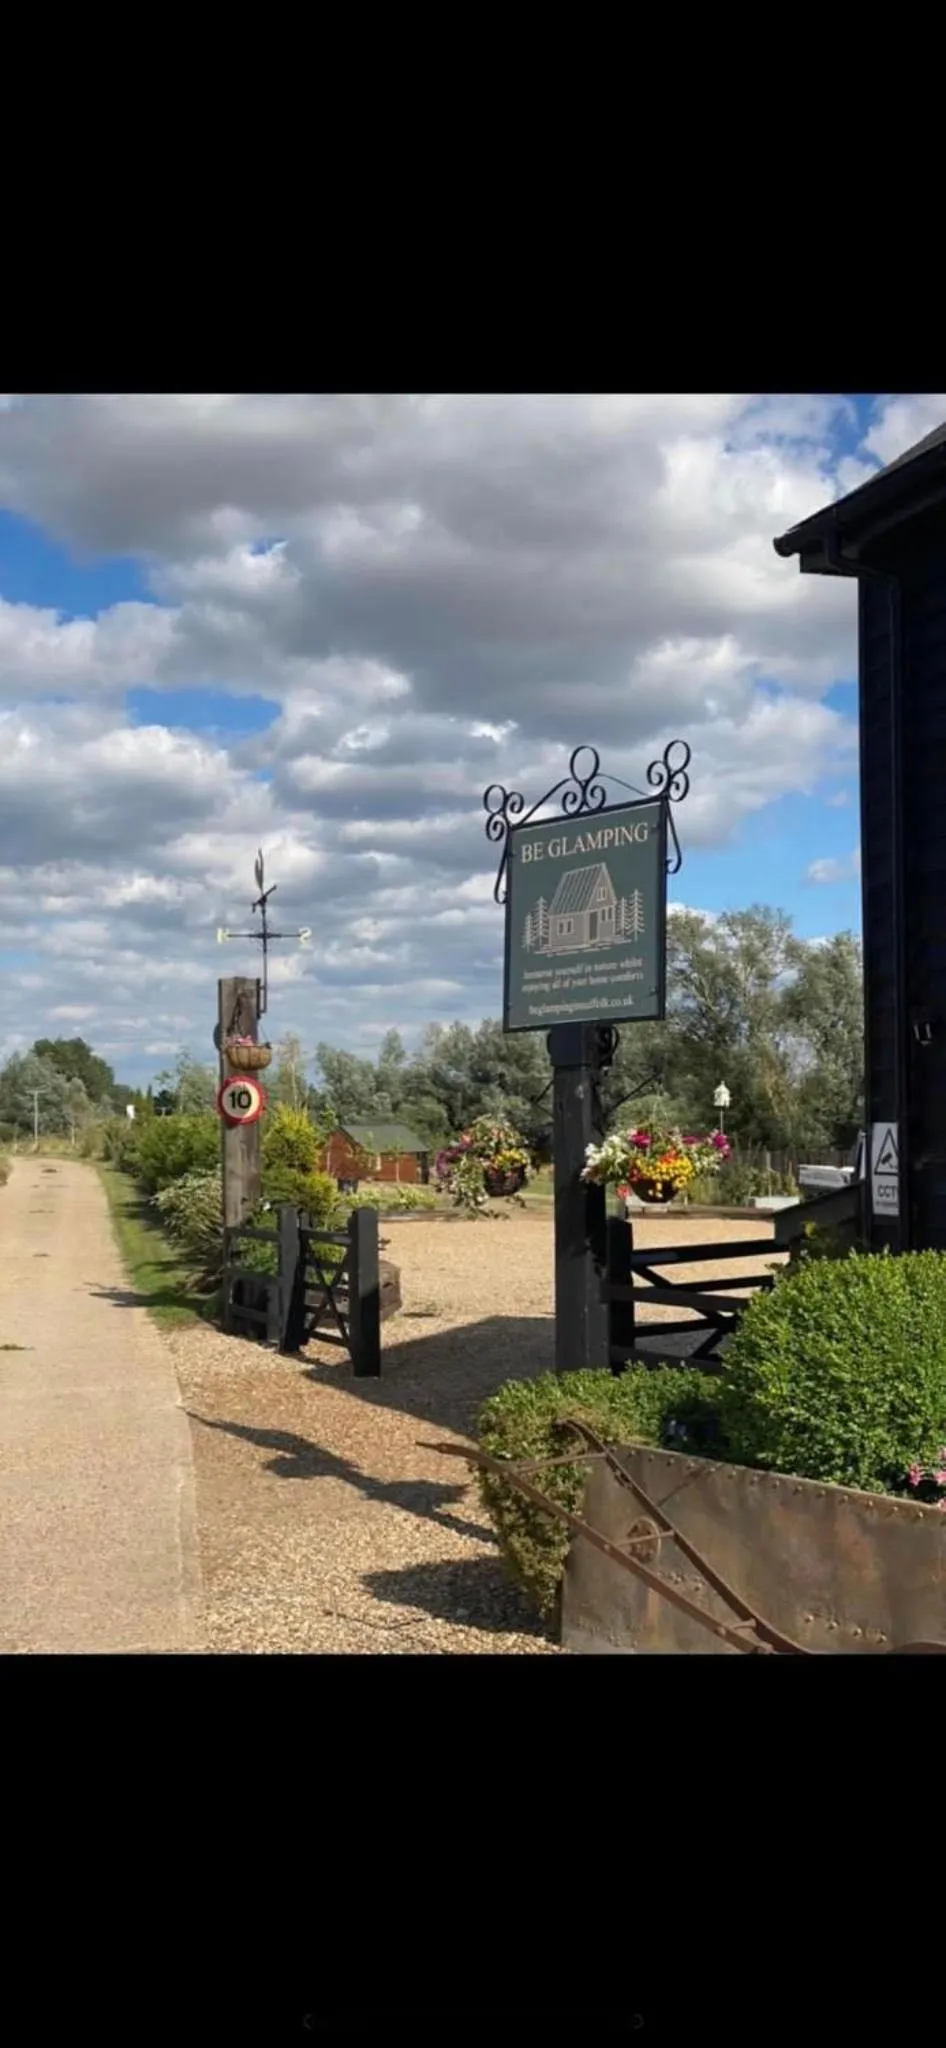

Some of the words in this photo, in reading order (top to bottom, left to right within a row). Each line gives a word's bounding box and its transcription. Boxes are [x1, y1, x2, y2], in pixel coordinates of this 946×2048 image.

[521, 842, 543, 863] BE
[547, 822, 649, 858] GLAMPING
[229, 1091, 252, 1109] 10
[877, 1184, 897, 1200] CCT
